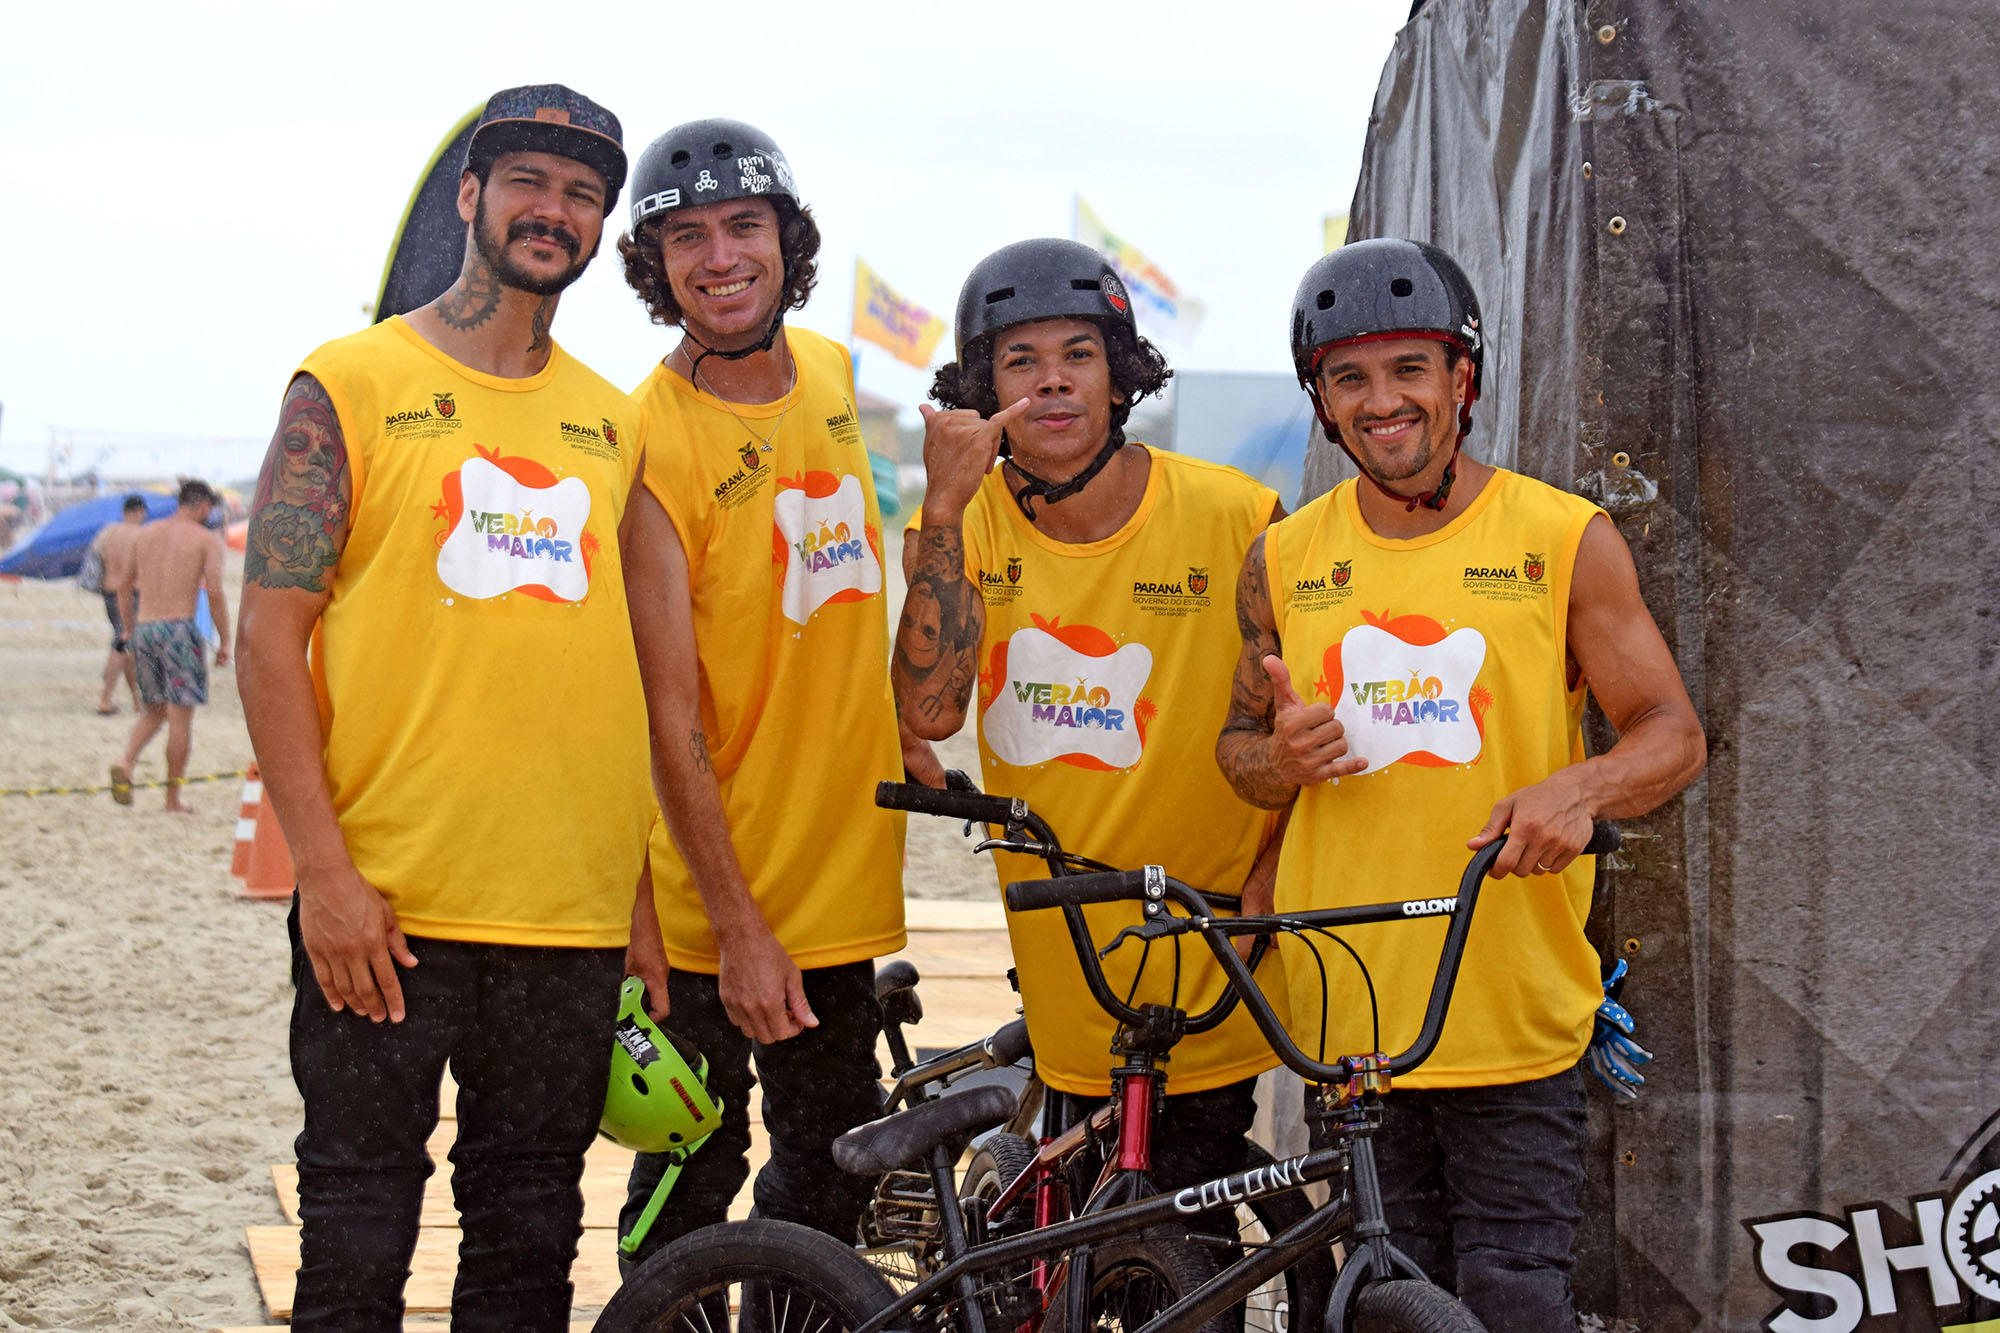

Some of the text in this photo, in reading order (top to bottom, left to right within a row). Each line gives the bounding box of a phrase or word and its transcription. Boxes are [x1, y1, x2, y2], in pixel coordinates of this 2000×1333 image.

[386, 407, 433, 426] PARANÁ
[386, 420, 463, 437] GOVERNO DO ESTADO
[470, 507, 558, 538] VERÃO
[487, 534, 573, 562] MAIOR
[1464, 565, 1518, 579] PARANÁ
[1133, 581, 1183, 594] PARANÁ
[1326, 590, 1353, 599] ESTADO
[1463, 581, 1502, 589] GOVERNO
[1518, 584, 1549, 594] ESTADO
[1133, 596, 1169, 605] GOVERNO
[1183, 599, 1211, 607] ESTADO
[1012, 676, 1111, 708] VERÃO
[1351, 668, 1443, 706] VERÃO
[1031, 704, 1125, 731] MAIOR
[1371, 699, 1460, 726] MAIOR
[1402, 897, 1457, 916] COLONY
[623, 1025, 653, 1053] BMX
[1174, 1154, 1308, 1215] COLONY
